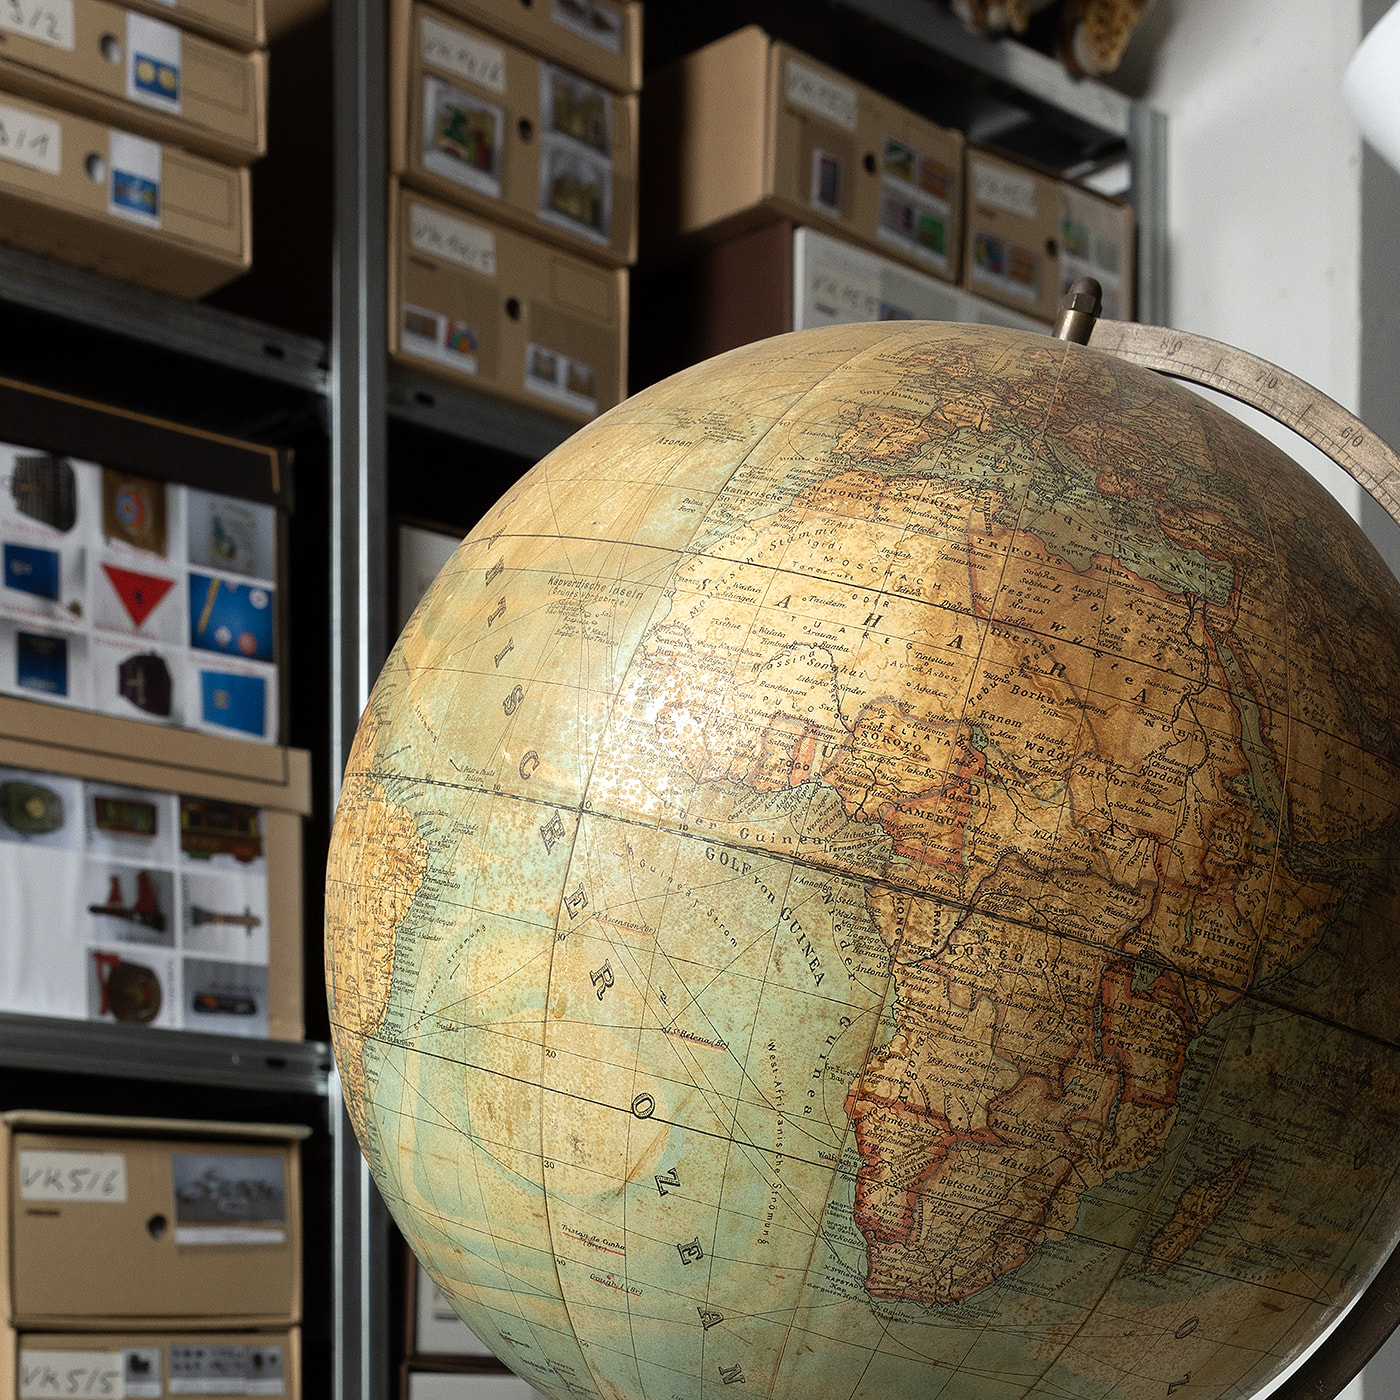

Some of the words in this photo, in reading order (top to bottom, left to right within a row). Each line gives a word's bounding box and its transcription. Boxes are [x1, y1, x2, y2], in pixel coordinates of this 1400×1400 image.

[811, 485, 873, 502] MAROKKO
[976, 537, 1064, 566] TRIPOLIS
[1000, 584, 1051, 605] Fessan
[1010, 685, 1056, 706] Borku
[978, 710, 1022, 728] Kanem
[860, 730, 922, 752] SOKOTO
[778, 757, 810, 772] TOGO
[895, 803, 967, 828] KAMERUN
[706, 850, 751, 876] GOLF
[754, 875, 776, 903] von
[781, 906, 825, 987] GUINEA
